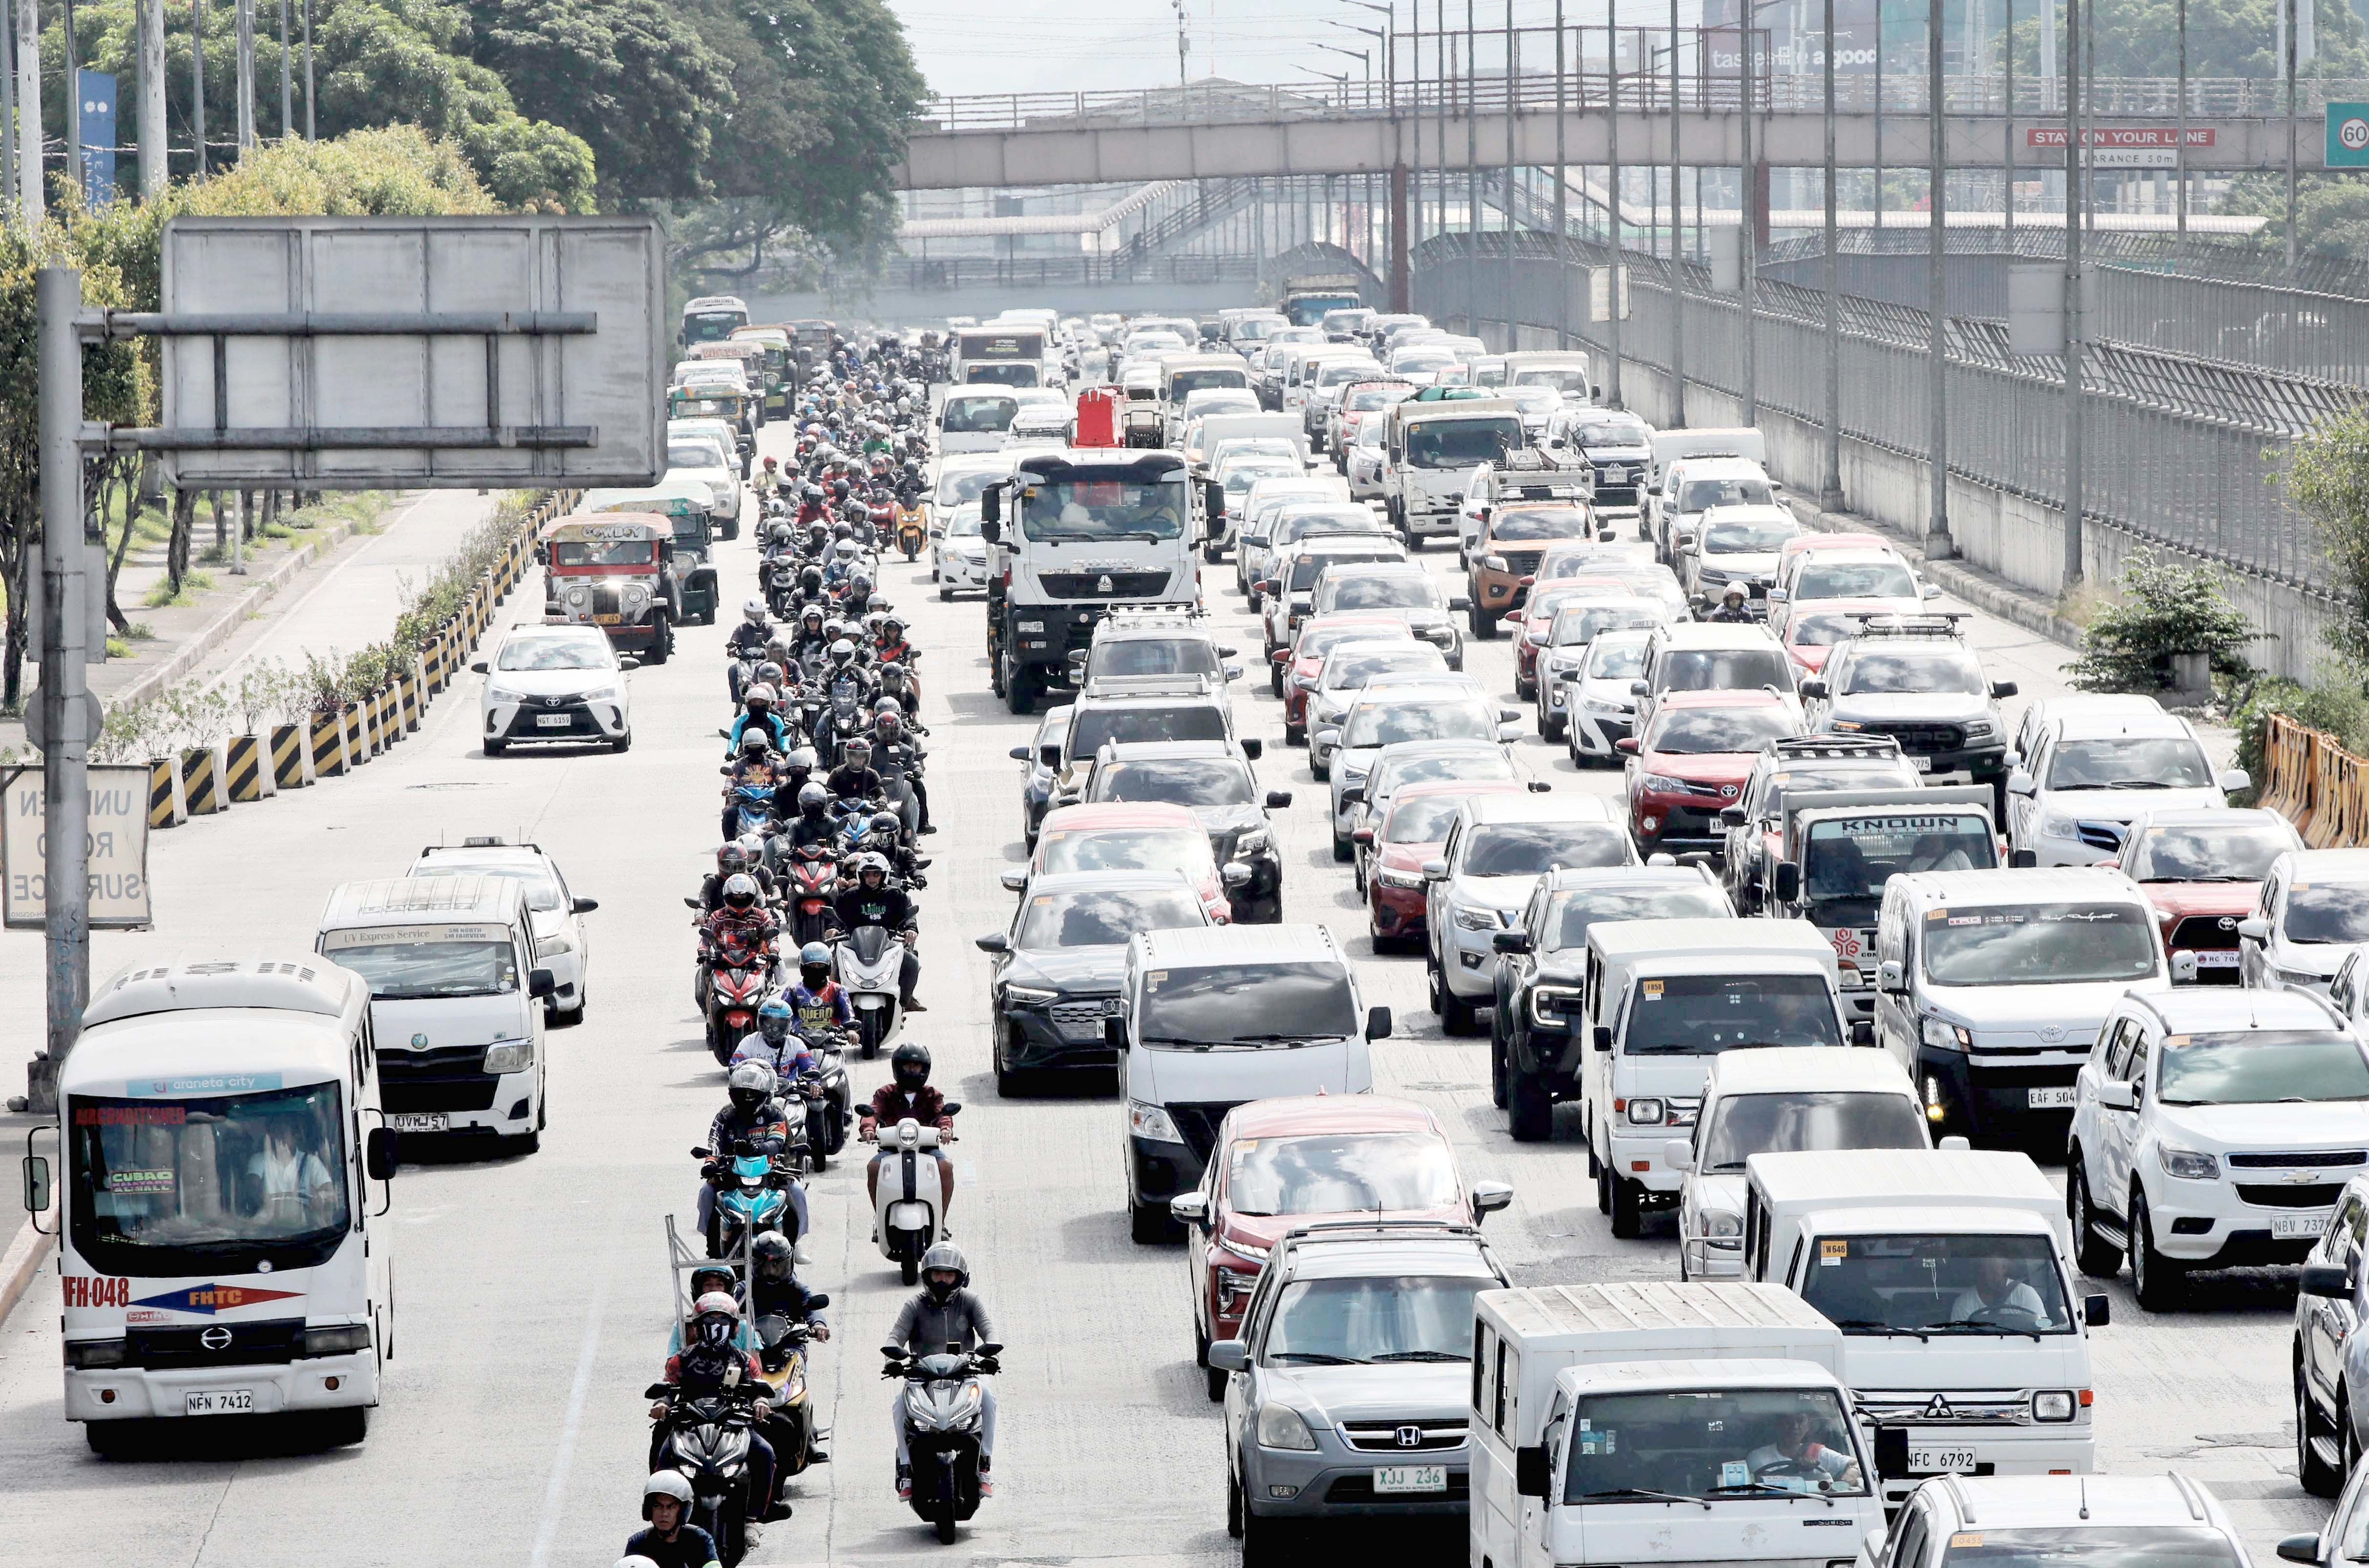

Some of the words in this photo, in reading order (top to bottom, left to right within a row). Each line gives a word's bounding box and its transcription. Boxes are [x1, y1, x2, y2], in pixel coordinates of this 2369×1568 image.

[1713, 50, 1775, 68] tases
[2035, 132, 2074, 143] STA
[2112, 131, 2157, 143] YOUR
[2164, 132, 2207, 143] LNE
[2344, 126, 2367, 142] 60
[581, 525, 643, 539] COWBOY
[1842, 818, 1958, 830] KNOWN
[344, 934, 358, 943] UV
[360, 932, 395, 942] Express
[397, 930, 430, 939] Service
[174, 1078, 224, 1090] araneta
[229, 1075, 255, 1090] city
[2031, 1093, 2049, 1104] EAF
[112, 1171, 173, 1182] CUBAO
[2275, 1221, 2295, 1233] NBV
[1826, 1245, 1845, 1254] W646
[190, 1290, 243, 1306] FHTC
[190, 1397, 212, 1410] NFN
[220, 1395, 251, 1408] 7412
[1908, 1453, 1930, 1466] NFC
[1940, 1453, 1973, 1466] 6792
[1380, 1470, 1404, 1484] XJJ
[1416, 1469, 1440, 1484] 236
